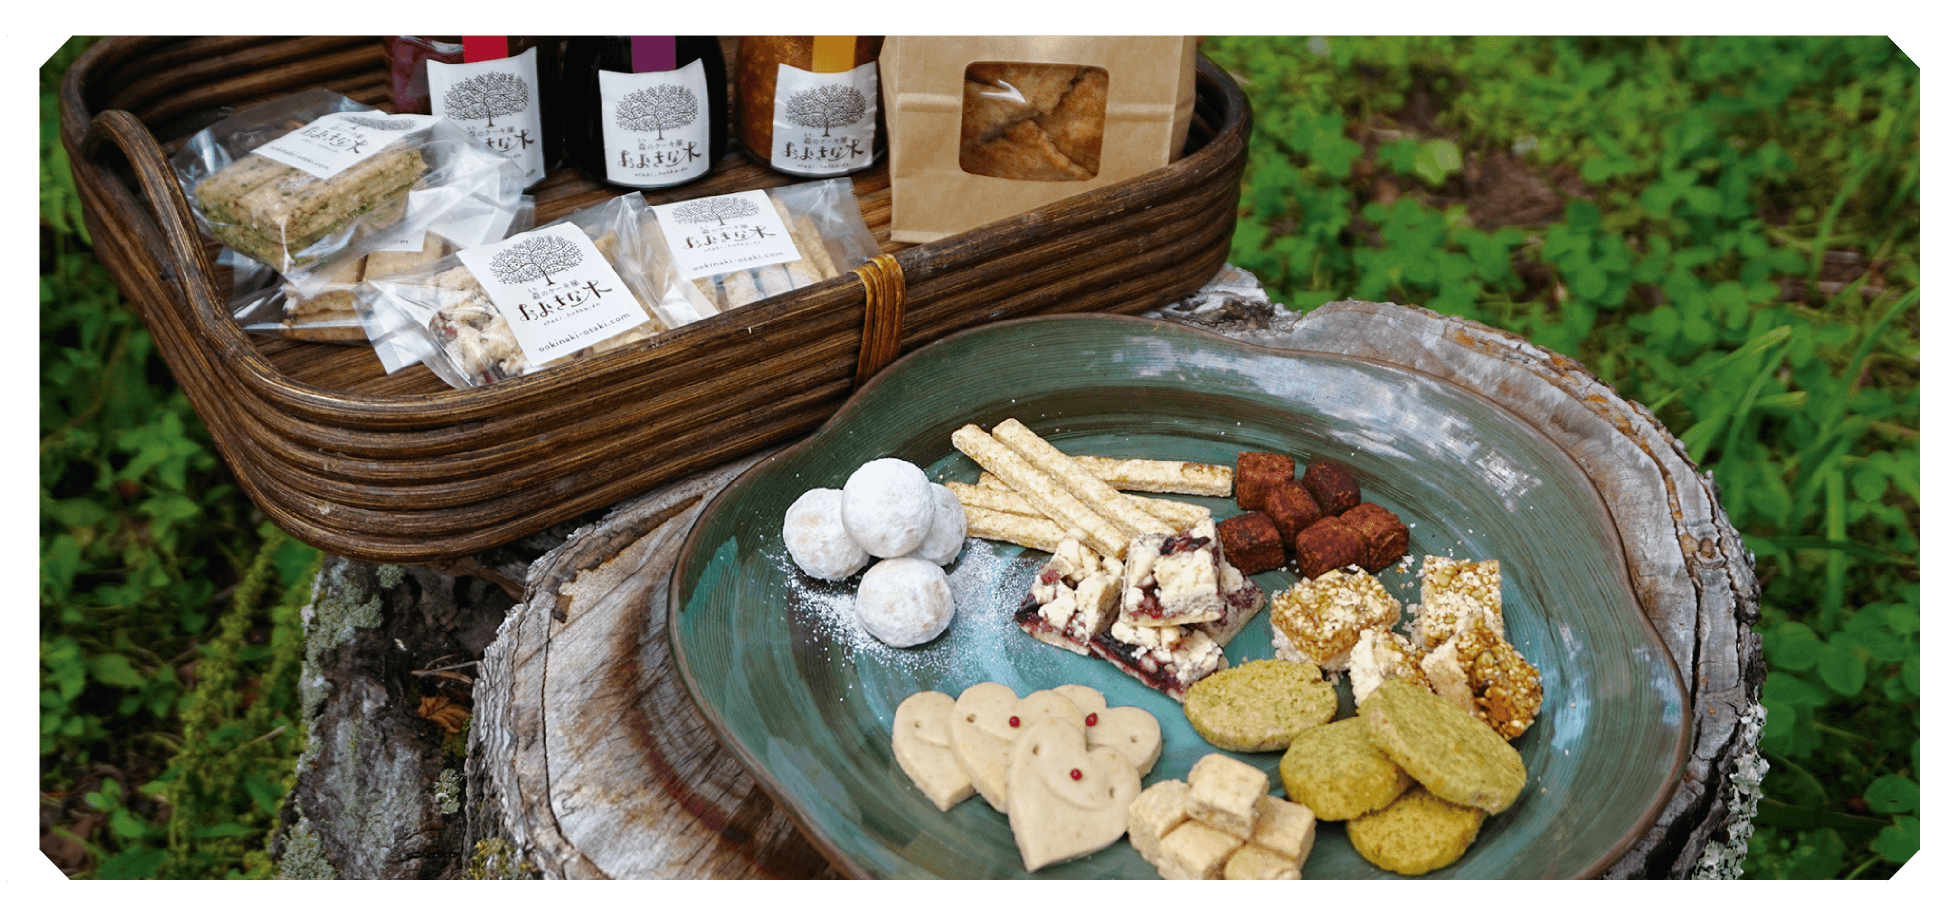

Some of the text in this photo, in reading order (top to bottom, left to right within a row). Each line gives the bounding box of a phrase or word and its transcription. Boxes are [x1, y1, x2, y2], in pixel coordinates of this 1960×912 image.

[692, 251, 785, 271] ookinaki-otaki.com
[518, 280, 613, 322] おおきな木
[538, 312, 631, 352] ookinaki-otaki.com
